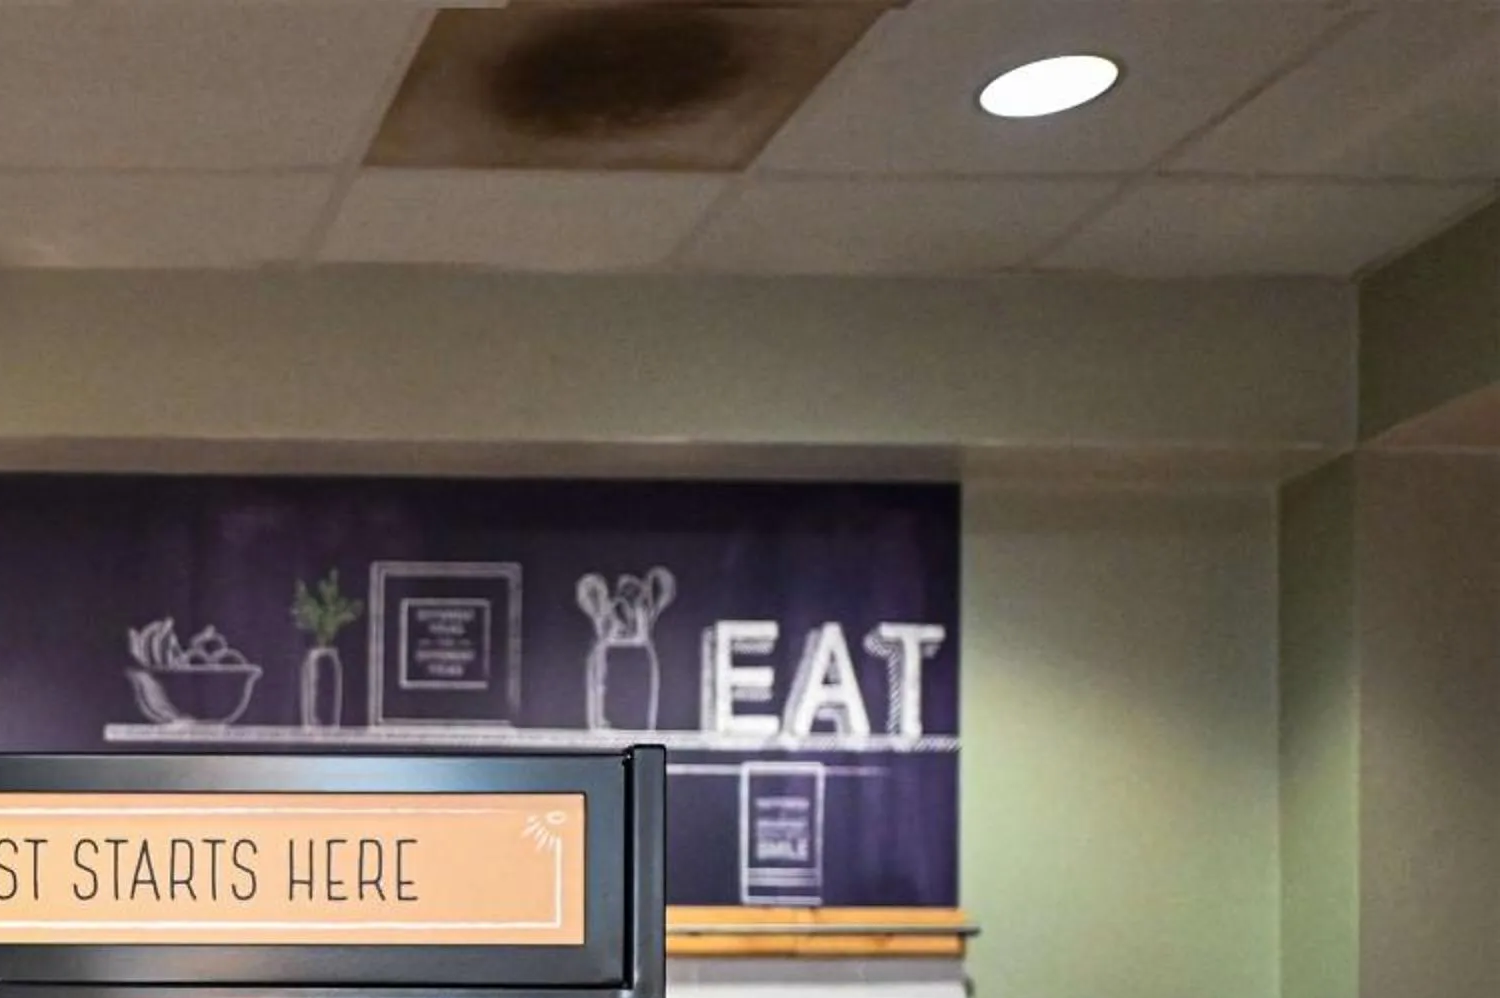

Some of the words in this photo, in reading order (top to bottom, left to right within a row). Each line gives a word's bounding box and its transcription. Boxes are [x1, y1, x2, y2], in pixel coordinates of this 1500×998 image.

[704, 619, 946, 749] EAT
[73, 837, 259, 902] STARTS
[289, 838, 419, 902] HERE
